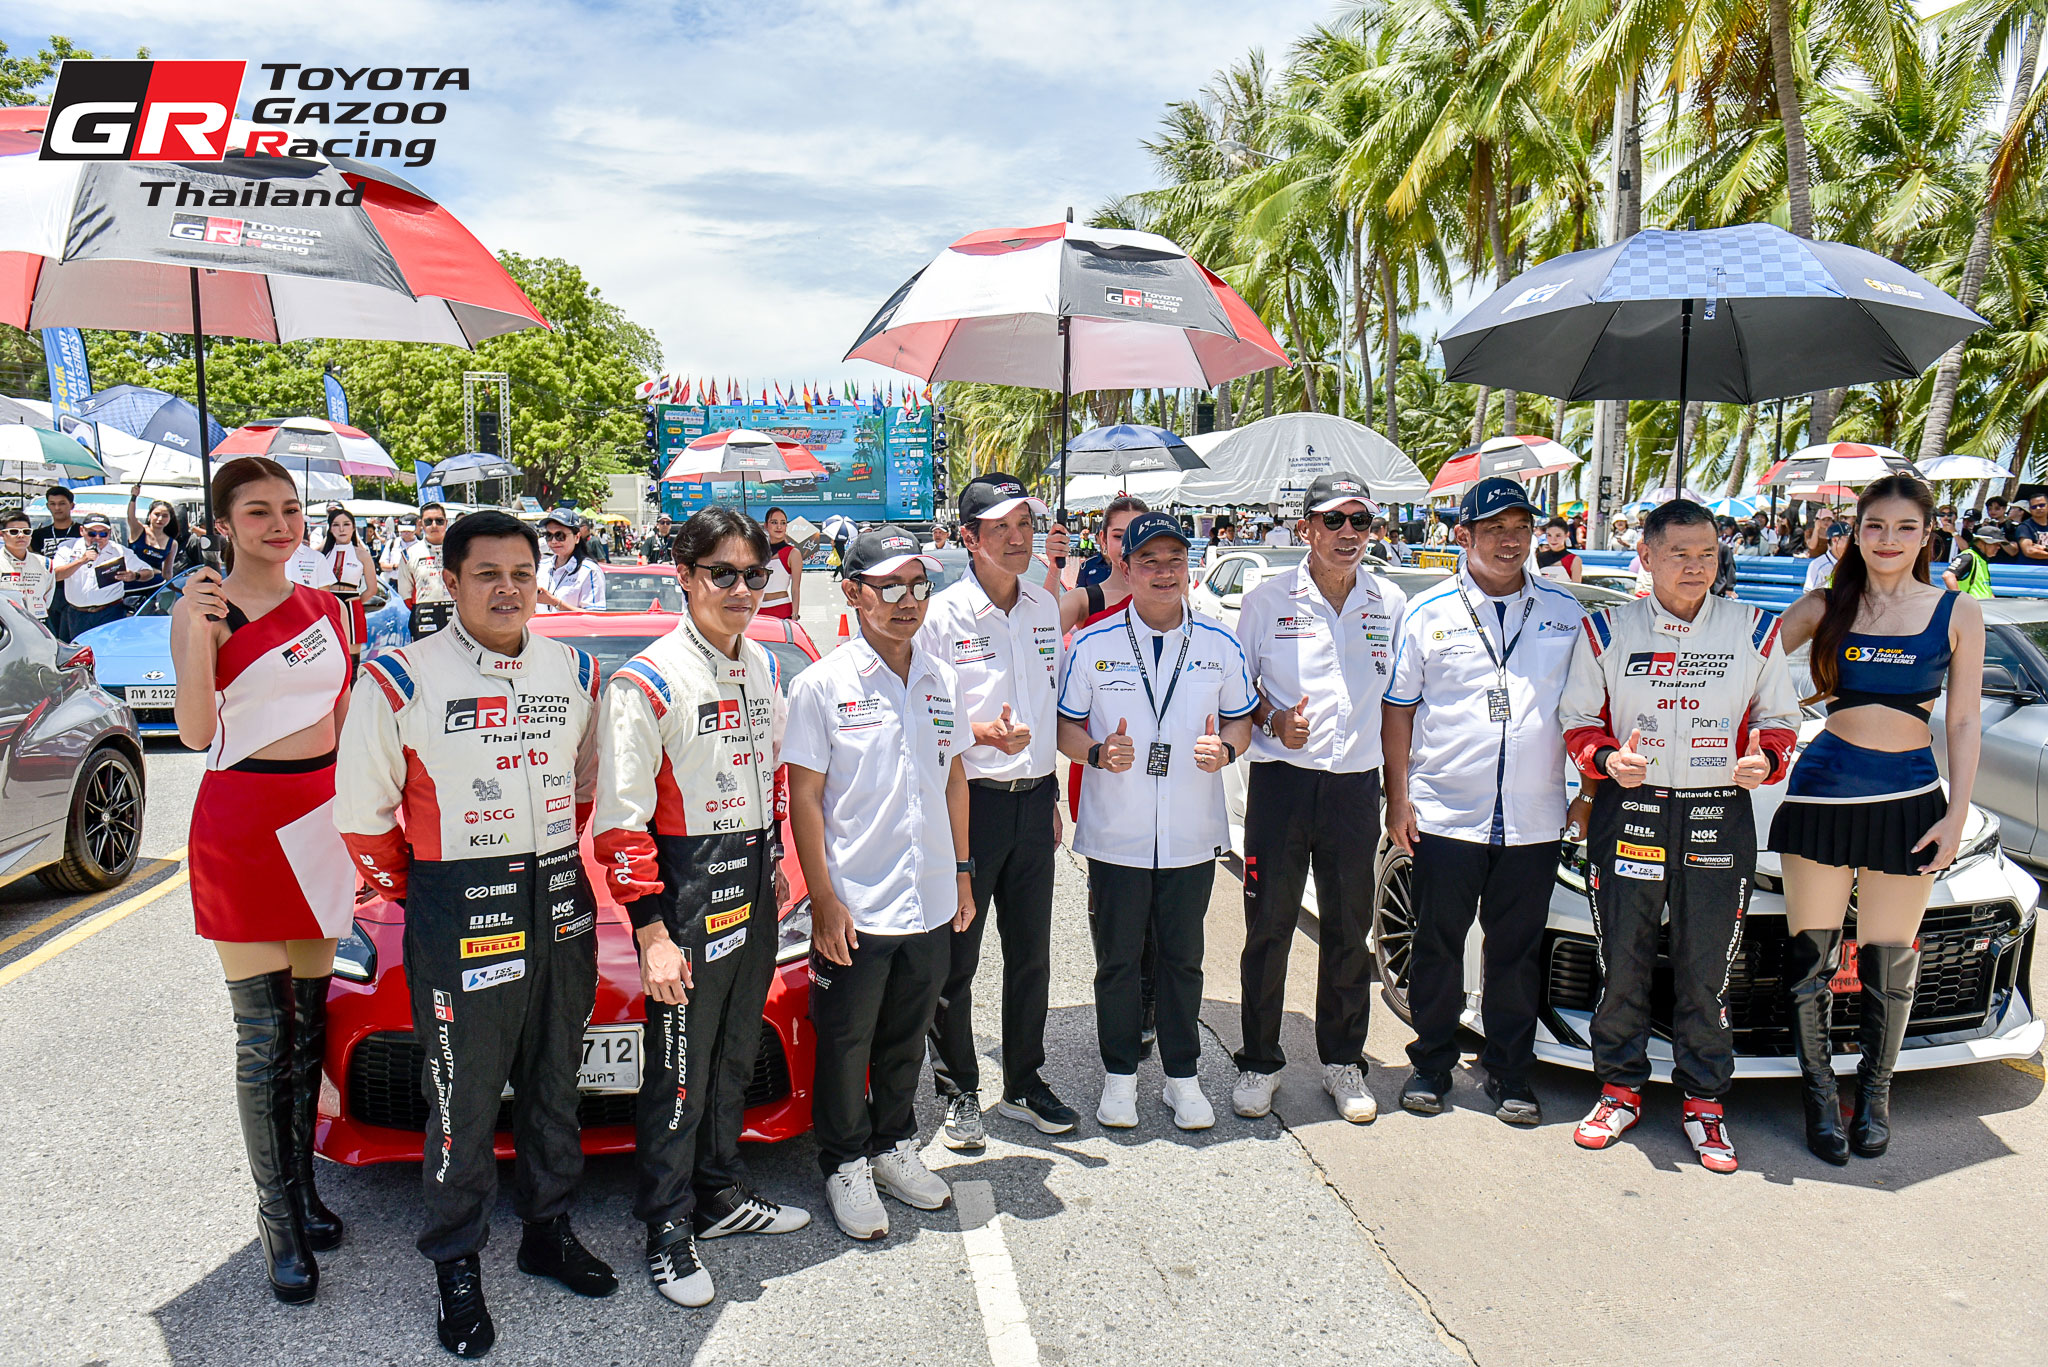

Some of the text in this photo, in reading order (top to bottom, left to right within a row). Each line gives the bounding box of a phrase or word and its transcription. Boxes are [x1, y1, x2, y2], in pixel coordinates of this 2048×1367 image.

[172, 222, 241, 244] GR
[247, 220, 322, 238] TOYOTA
[246, 231, 315, 247] GAZOO
[246, 238, 309, 256] Racing
[1106, 292, 1141, 307] GR
[1143, 291, 1184, 303] TOYOTA
[1144, 302, 1178, 314] Racing
[58, 330, 81, 415] THAILAND
[1664, 623, 1690, 633] arto
[300, 628, 321, 645] TOYOTA
[307, 638, 327, 654] Racing
[287, 648, 308, 667] GR
[303, 646, 327, 666] Thailand
[1371, 650, 1387, 658] arto
[1681, 652, 1735, 660] TOYOTA
[494, 660, 523, 670] arto
[1627, 661, 1673, 676] GR
[1678, 660, 1729, 668] GAZOO
[1676, 668, 1726, 678] Racing
[1650, 680, 1707, 689] Thailand
[151, 689, 176, 699] 2122
[518, 694, 570, 704] TOYOTA
[517, 705, 567, 714] GAZOO
[1657, 696, 1700, 710] arto
[447, 708, 505, 732] GR
[513, 714, 566, 726] Racing
[699, 711, 740, 734] GR
[480, 730, 551, 743] Thailand
[937, 739, 951, 747] arto
[1642, 737, 1665, 747] SCG
[1693, 739, 1726, 747] MOTUL
[496, 748, 549, 770] arto
[548, 796, 570, 811] MOTUL
[721, 797, 746, 810] SCG
[1640, 804, 1661, 813] ENKEI
[483, 808, 515, 821] SCG
[1690, 806, 1725, 816] ENDLESS
[1624, 824, 1655, 835] DRL
[1691, 830, 1718, 839] NGK
[1621, 844, 1660, 858] PIRELLI
[727, 857, 748, 871] ENKEI
[490, 883, 517, 896] ENKEI
[712, 885, 744, 900] DRL
[1736, 877, 1747, 919] Racing
[552, 899, 574, 916] NGK
[470, 912, 514, 926] DRL
[711, 907, 747, 929] PIRELLI
[467, 936, 520, 954] PIRELLI
[495, 966, 513, 975] TSS
[434, 991, 447, 1020] GR
[663, 1011, 673, 1071] Thailand
[439, 1024, 454, 1080] TOYOTA
[677, 1035, 688, 1085] GAZOO
[669, 1086, 687, 1131] Racing
